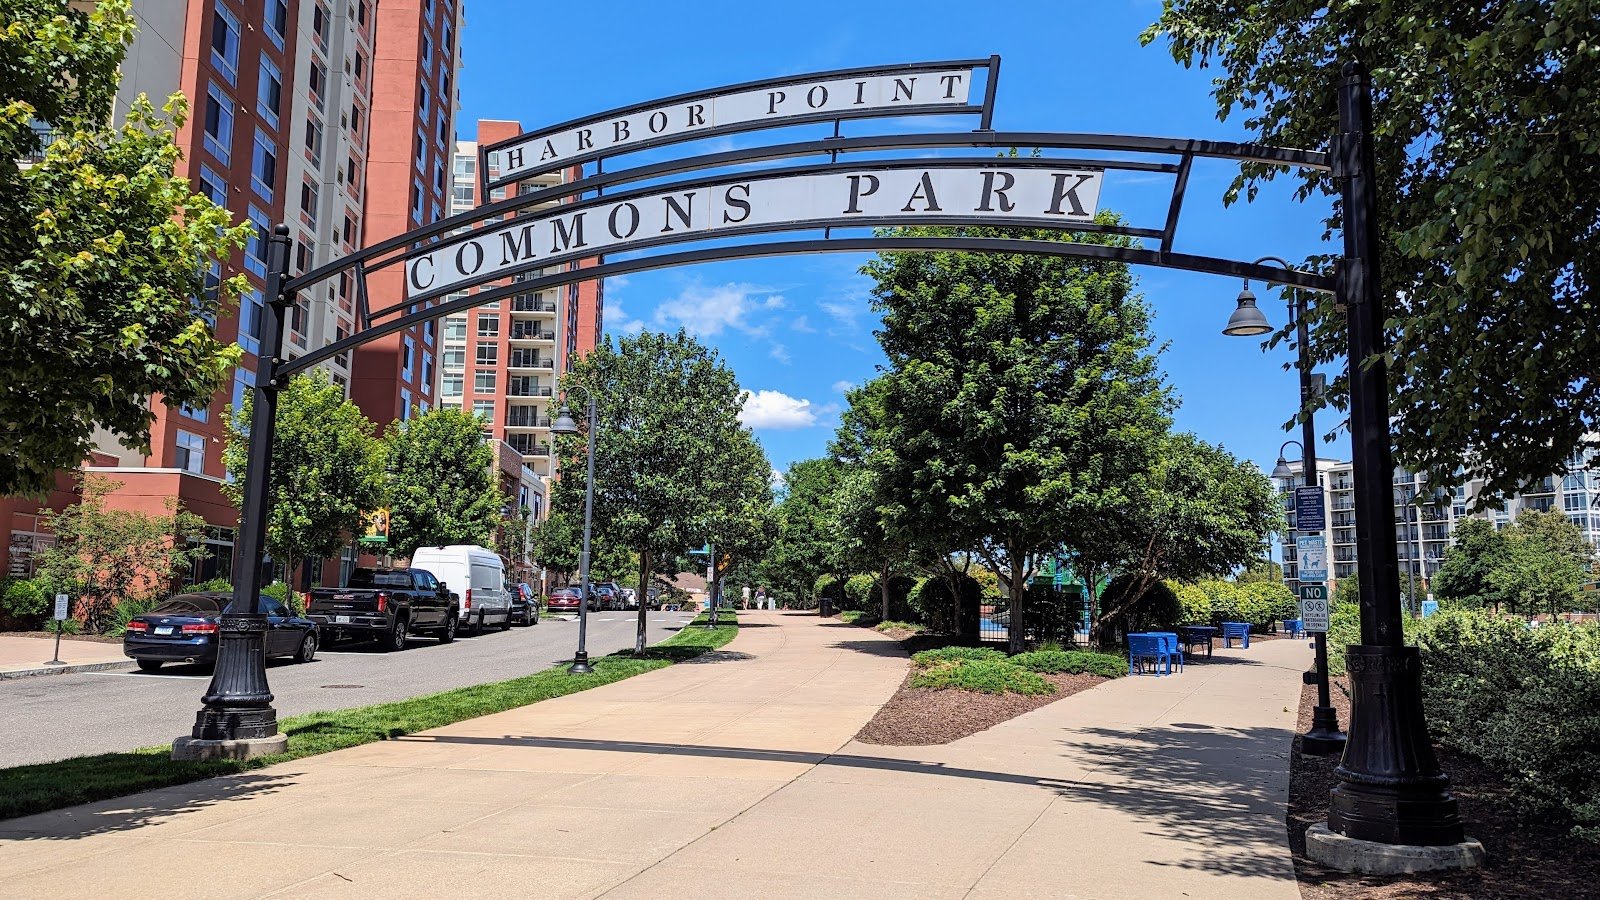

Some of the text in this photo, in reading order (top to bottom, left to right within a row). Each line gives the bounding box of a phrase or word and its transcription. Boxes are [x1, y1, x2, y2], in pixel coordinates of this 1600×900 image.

[506, 75, 962, 171] HARBOR POINT
[410, 171, 1095, 291] COMMONS PARK
[1306, 588, 1321, 598] NO
